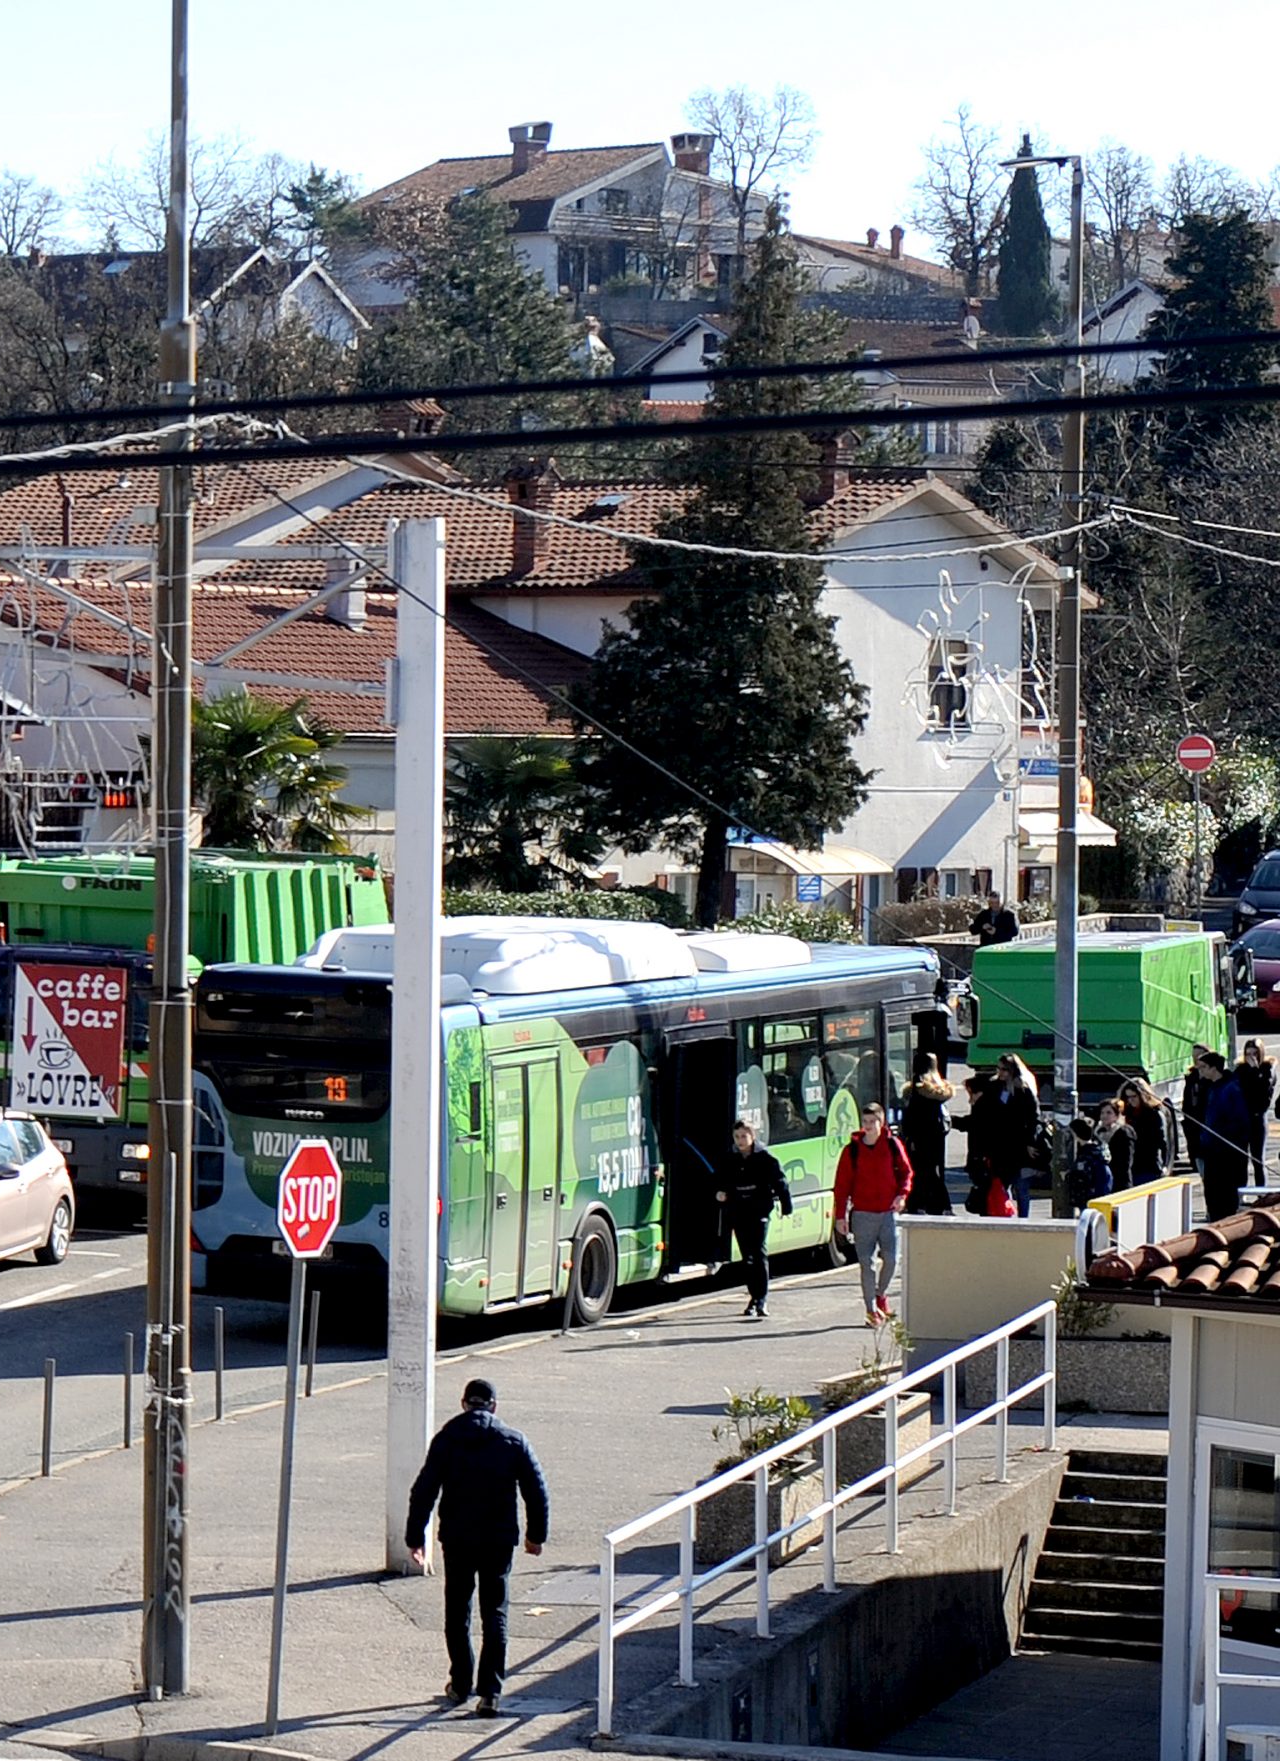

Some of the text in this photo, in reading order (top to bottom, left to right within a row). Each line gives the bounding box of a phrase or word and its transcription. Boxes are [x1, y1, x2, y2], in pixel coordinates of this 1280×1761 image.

[81, 877, 143, 891] FAUN
[37, 973, 121, 1001] caffe
[61, 1001, 118, 1028] bar
[283, 1175, 336, 1223] STOP
